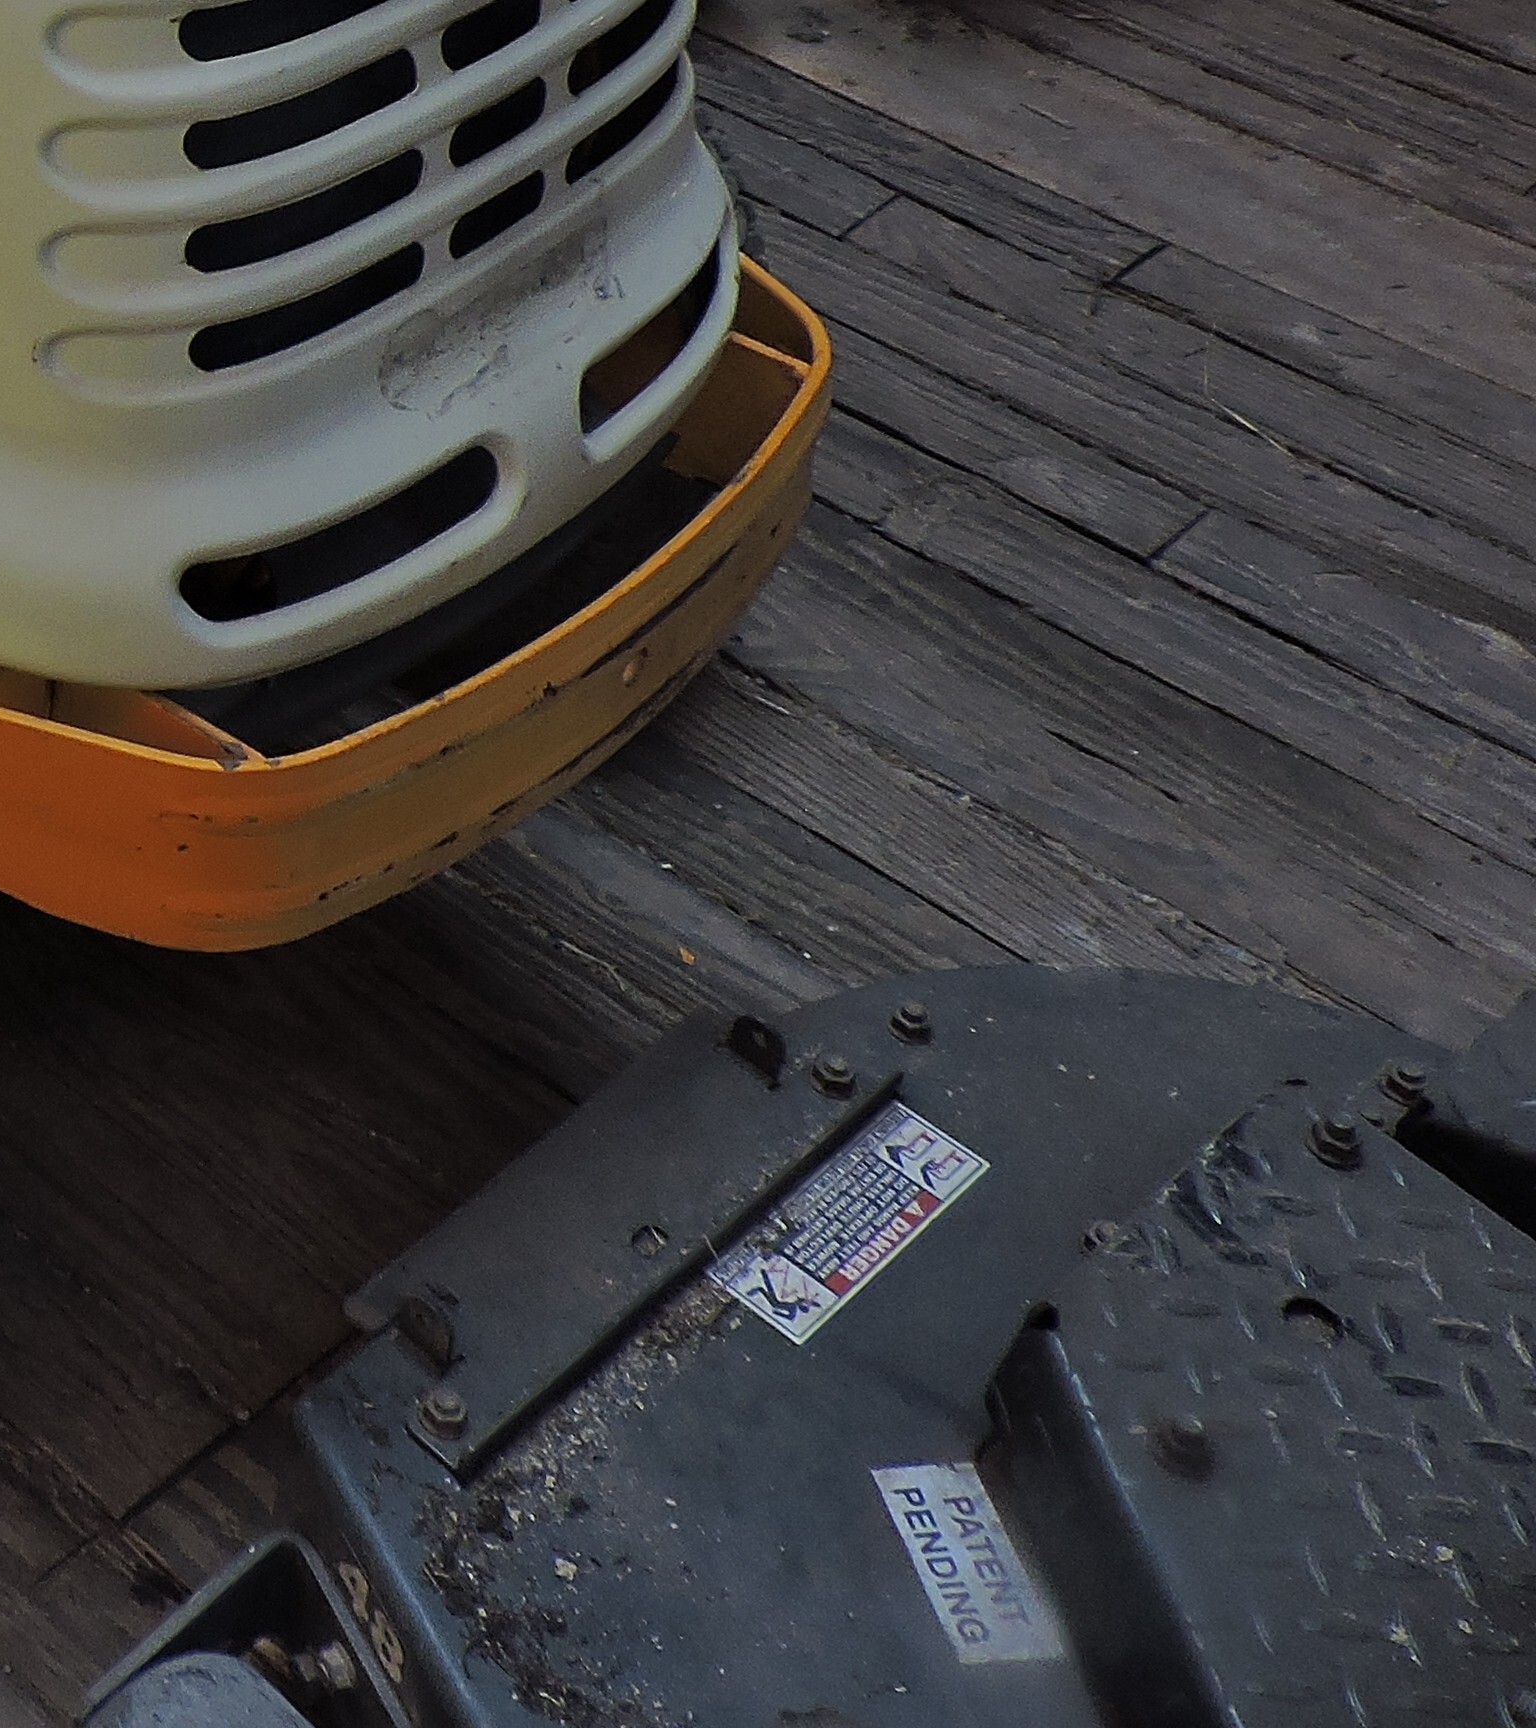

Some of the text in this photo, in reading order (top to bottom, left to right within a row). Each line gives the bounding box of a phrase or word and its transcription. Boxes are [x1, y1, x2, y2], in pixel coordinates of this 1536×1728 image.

[891, 1175, 910, 1190] DO
[793, 1220, 843, 1264] DEFLECTOR
[837, 1204, 880, 1241] OPERATE
[837, 1215, 912, 1283] DANGER
[892, 1486, 990, 1644] PENDING
[942, 1495, 1031, 1625] PATENT
